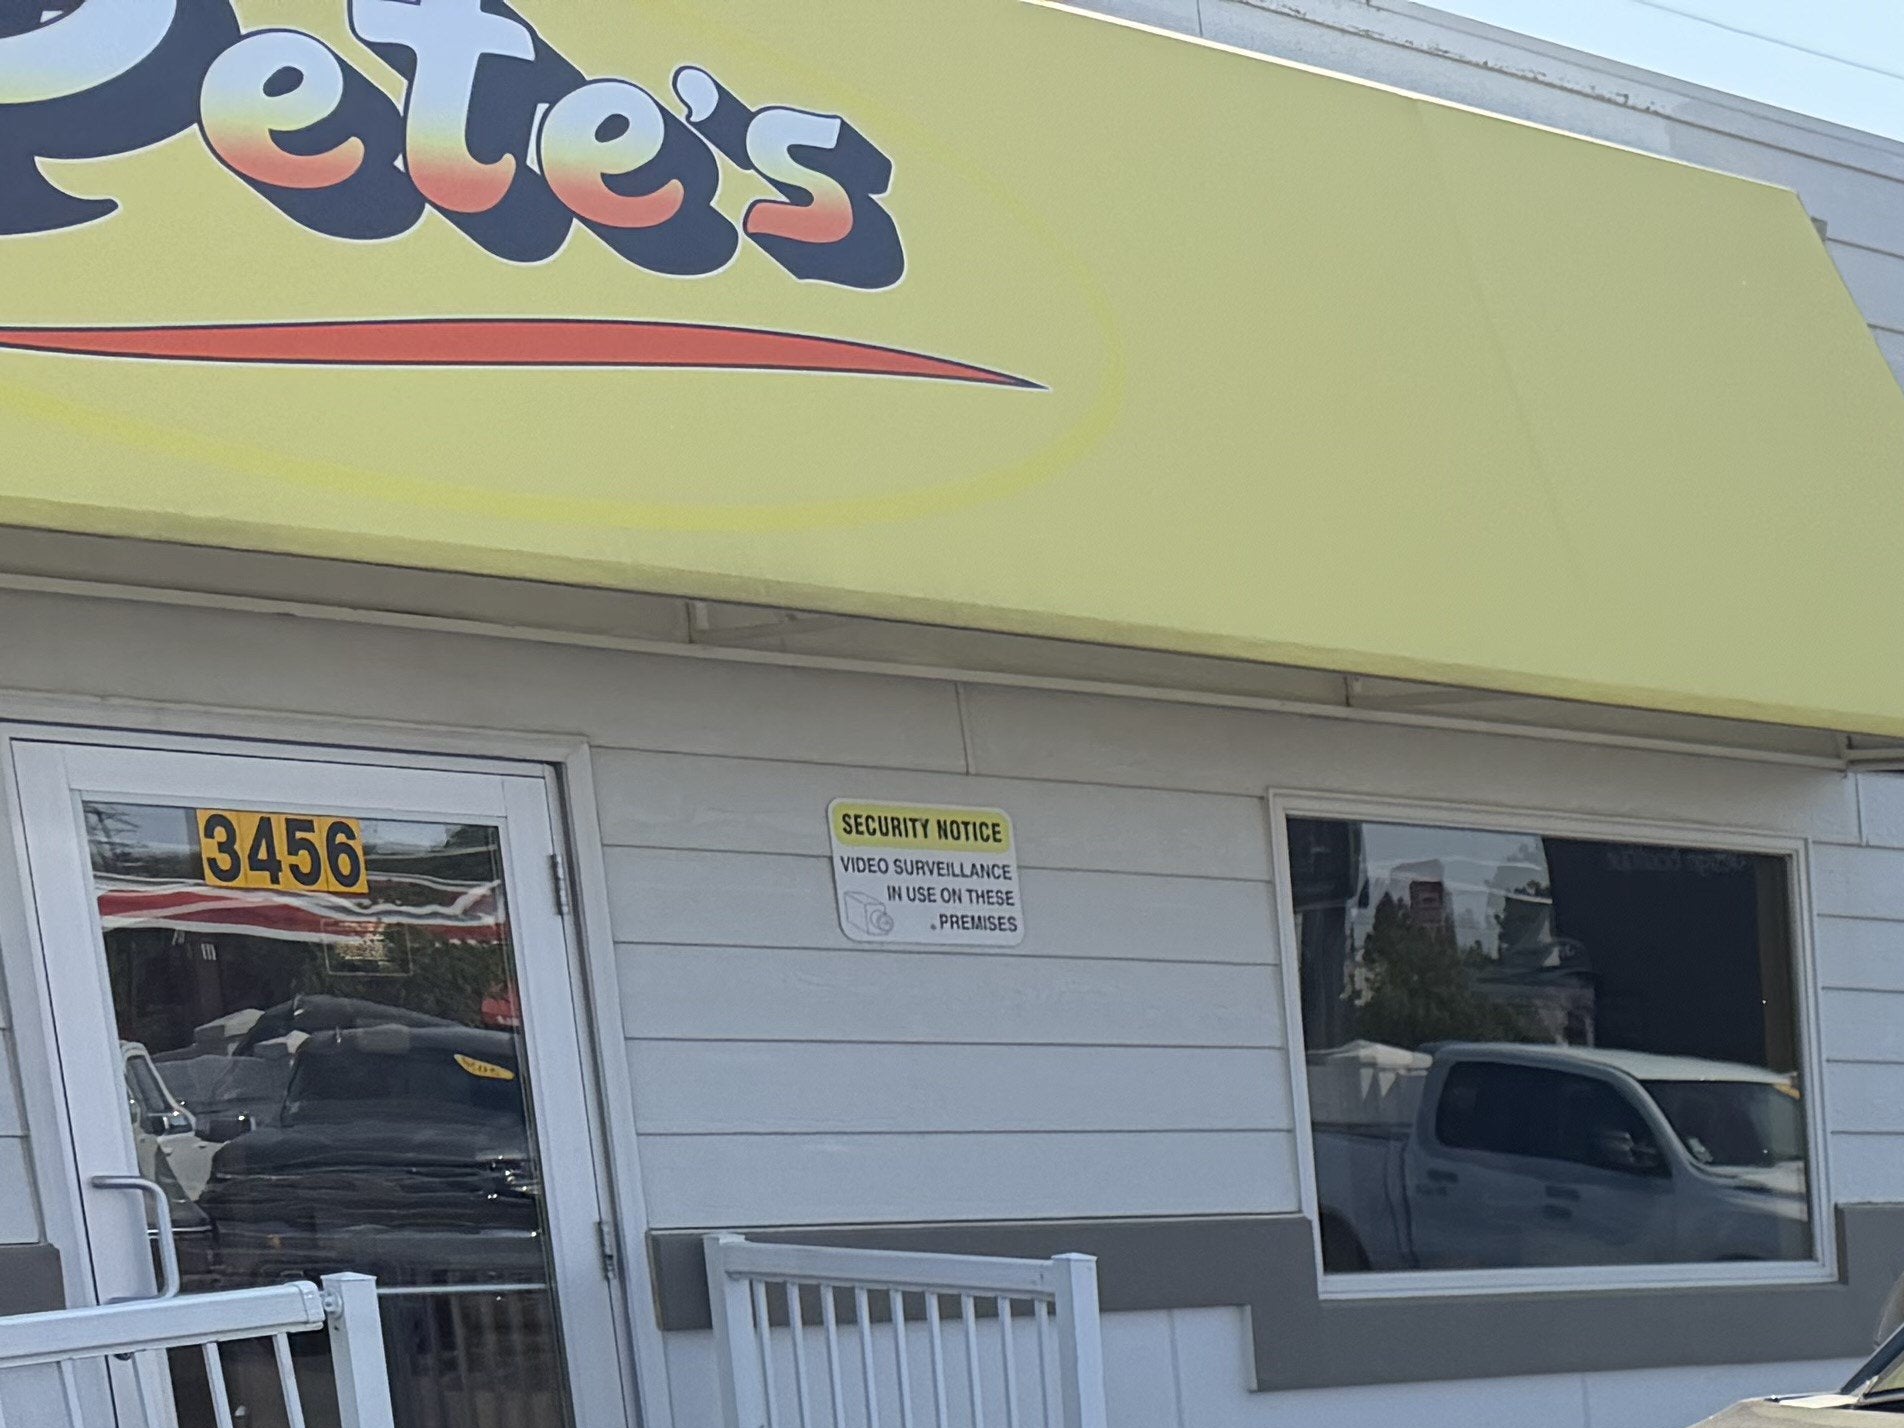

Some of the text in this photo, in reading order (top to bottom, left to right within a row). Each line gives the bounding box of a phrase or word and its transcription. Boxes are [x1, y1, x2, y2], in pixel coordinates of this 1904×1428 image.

[841, 813, 1002, 843] SECURITY NOTICE
[204, 814, 361, 888] 3456
[840, 855, 1013, 880] VIDEO SURVEILLANCE
[887, 885, 1015, 907] IN USE ON THESE
[939, 913, 1018, 932] PREMISES
